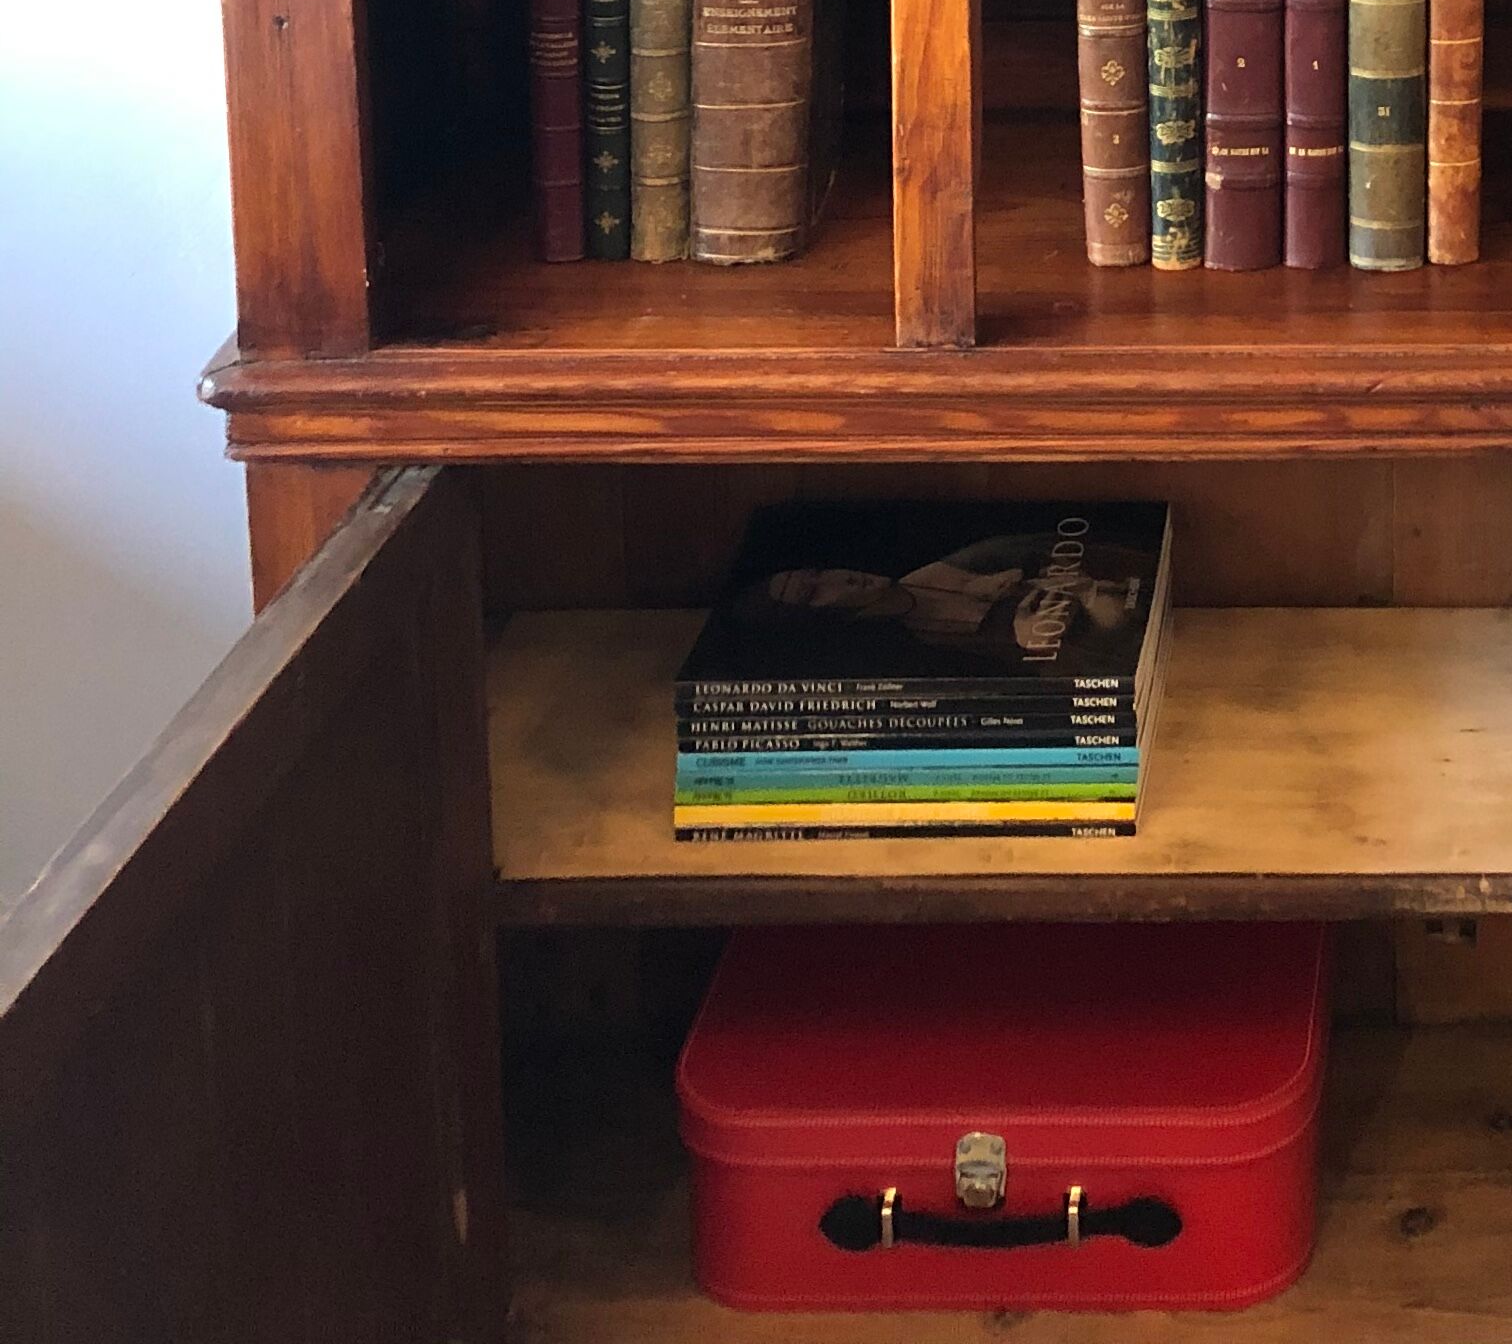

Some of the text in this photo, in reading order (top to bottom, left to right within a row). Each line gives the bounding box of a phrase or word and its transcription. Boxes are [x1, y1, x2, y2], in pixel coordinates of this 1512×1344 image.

[703, 6, 797, 17] ENSEIGNEMENT
[1022, 517, 1089, 661] LEONARDO
[695, 683, 772, 695] LEONARDO
[778, 682, 796, 694] DA
[801, 682, 843, 693] VINCI
[1074, 679, 1119, 688] TASCHEN
[693, 700, 876, 712] CASPAR DAVID FRIEDRICH
[1072, 697, 1117, 707] TASCHEN
[1070, 714, 1116, 724] TASCHEN
[690, 722, 735, 732] HENRI
[741, 720, 798, 731] MATISSE
[807, 719, 882, 729] GOUACHES
[696, 740, 737, 750] PABLO
[742, 739, 800, 750] PICASSO
[1075, 735, 1119, 745] TASCHEN
[1076, 753, 1121, 761] TASCHEN
[1072, 827, 1116, 836] TASCHEN
